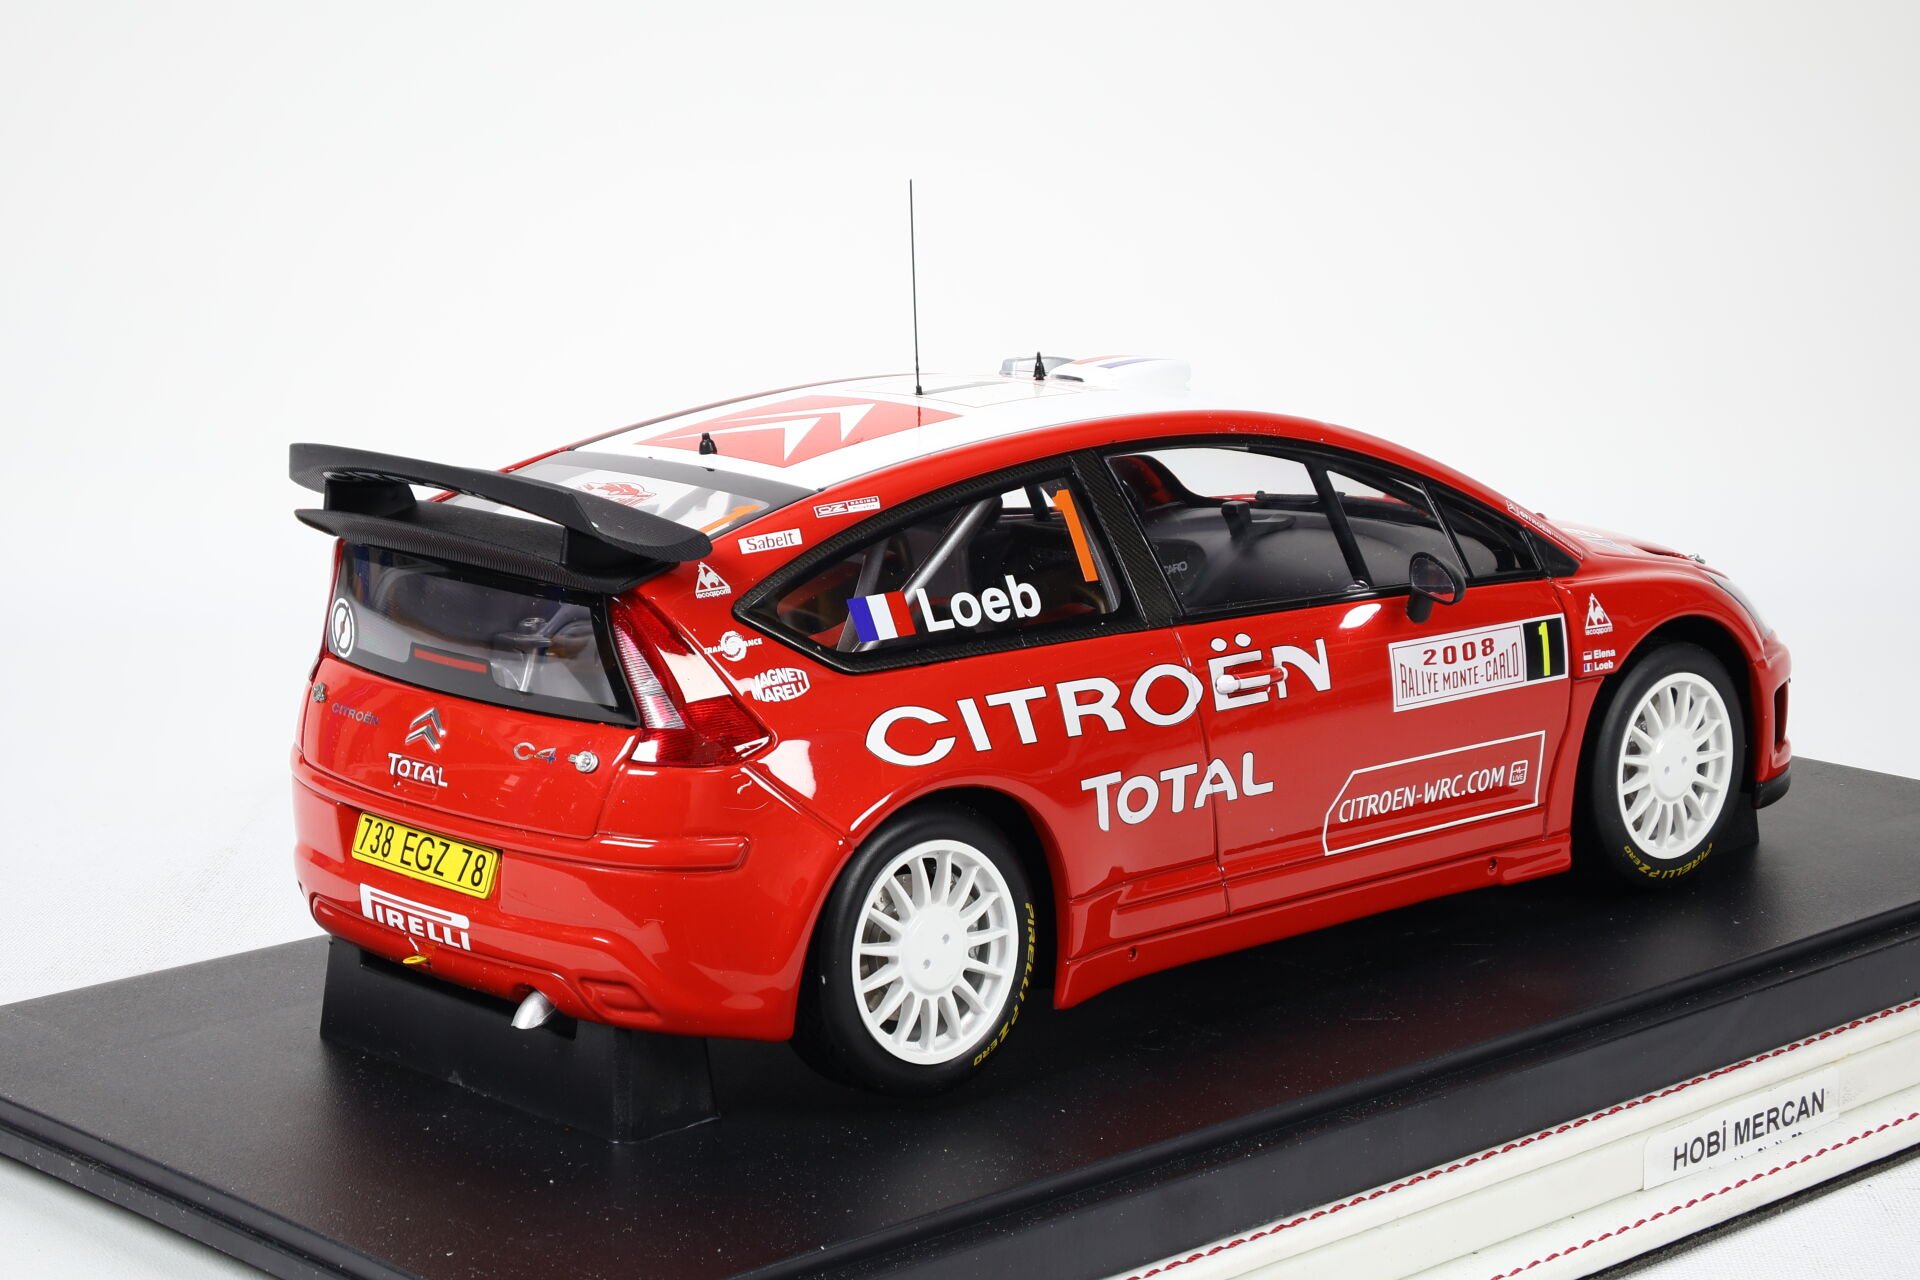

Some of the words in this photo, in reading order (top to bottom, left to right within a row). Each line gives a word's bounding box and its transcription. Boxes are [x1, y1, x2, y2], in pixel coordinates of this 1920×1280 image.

[746, 532, 795, 551] Sabelt
[1052, 489, 1099, 582] 1
[916, 575, 1042, 632] Loeb
[1400, 662, 1440, 699] RALLYE
[1443, 642, 1520, 690] MONTE-CARLO
[1423, 637, 1495, 666] 2008
[1538, 621, 1550, 677] 1
[1594, 660, 1614, 671] Loeb
[331, 703, 380, 726] CITROËN
[864, 632, 1332, 767] CITROËN
[388, 752, 448, 787] TOTAL
[513, 742, 557, 763] C4
[1080, 751, 1275, 832] TOTAL
[1338, 765, 1506, 823] CITROEN-WRC.COM
[359, 817, 395, 858] 738
[400, 831, 451, 877] EGZ
[457, 848, 487, 887] 78
[359, 883, 472, 951] PIRELLI
[1019, 902, 1036, 1002] PIRELLI
[1673, 1120, 1728, 1171] HOBİ
[1733, 1088, 1825, 1148] MERCAN
